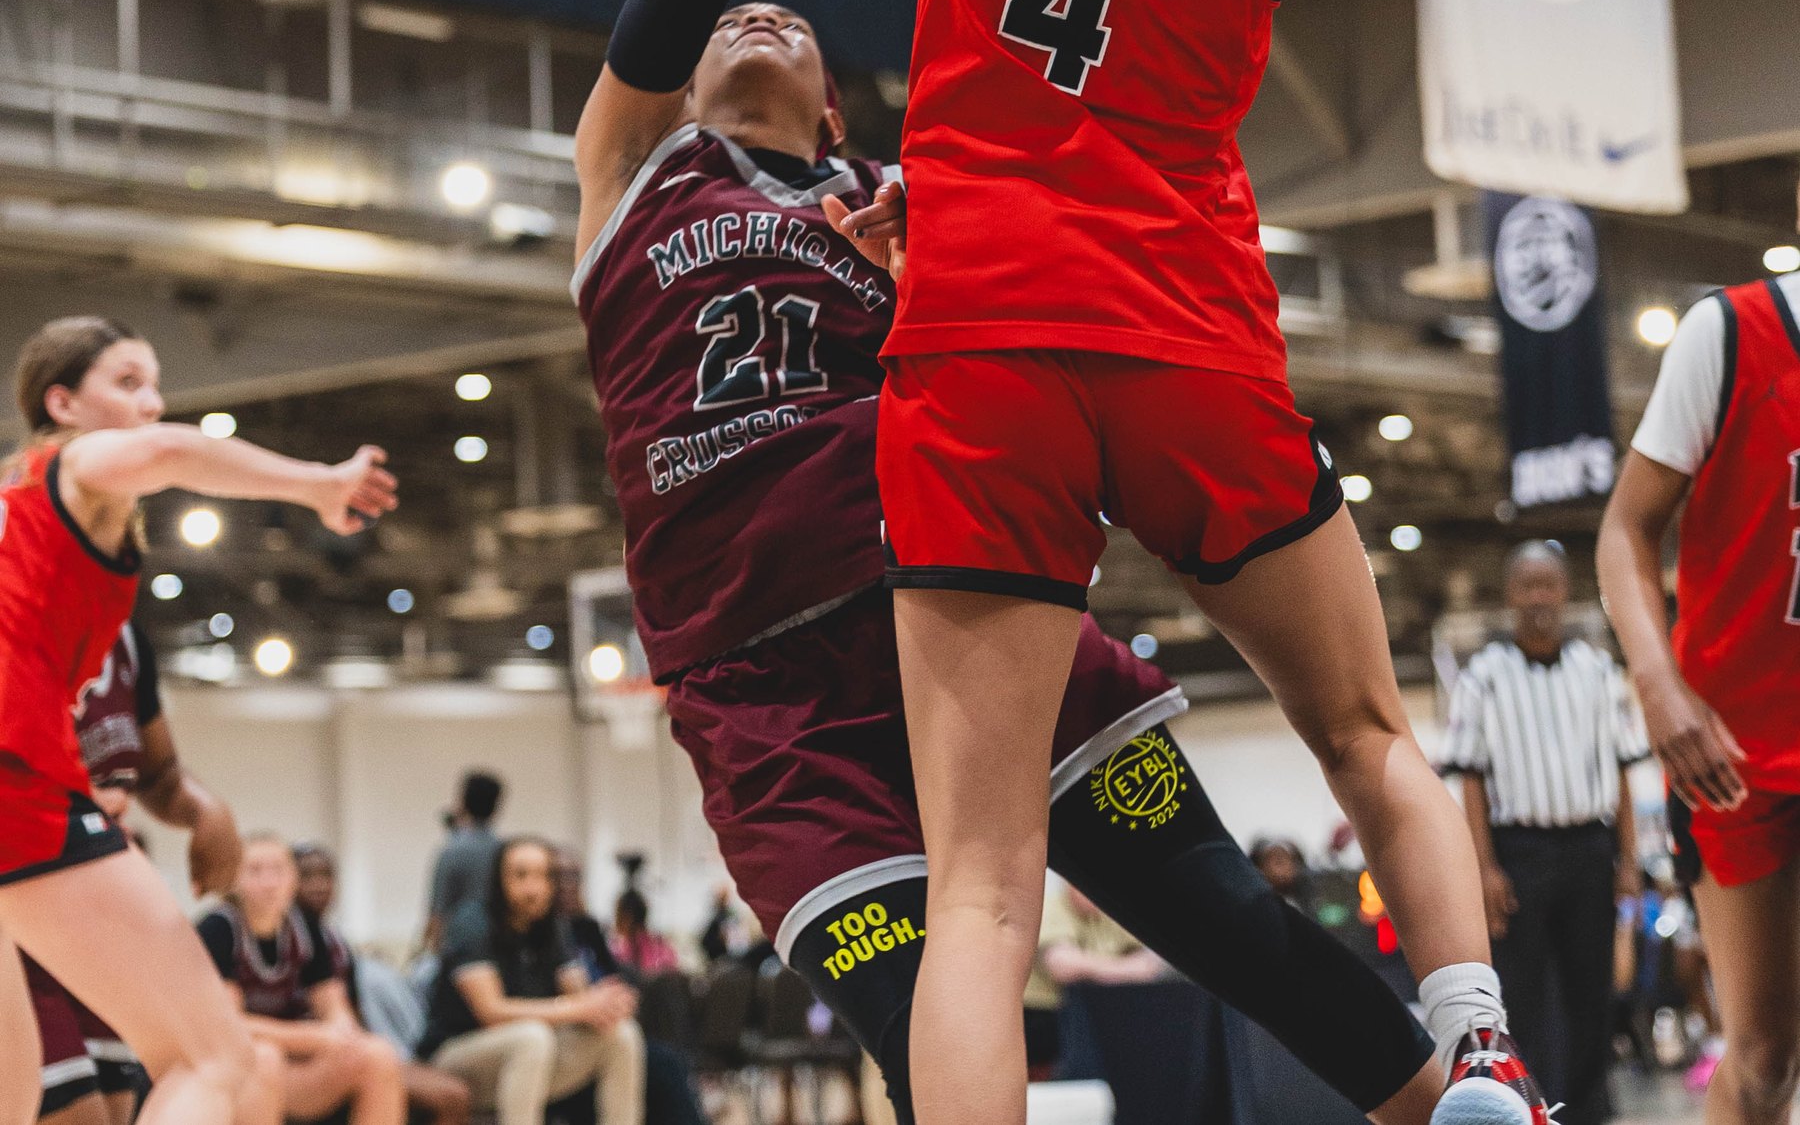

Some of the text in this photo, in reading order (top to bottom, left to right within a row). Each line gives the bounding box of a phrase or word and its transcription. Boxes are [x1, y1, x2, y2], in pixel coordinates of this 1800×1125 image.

[693, 285, 828, 413] 21
[1090, 767, 1110, 811] NIKE
[1113, 753, 1168, 798] EYBL
[1148, 800, 1180, 829] 2024
[825, 902, 888, 946] TOO
[822, 917, 926, 981] TOUGH.
